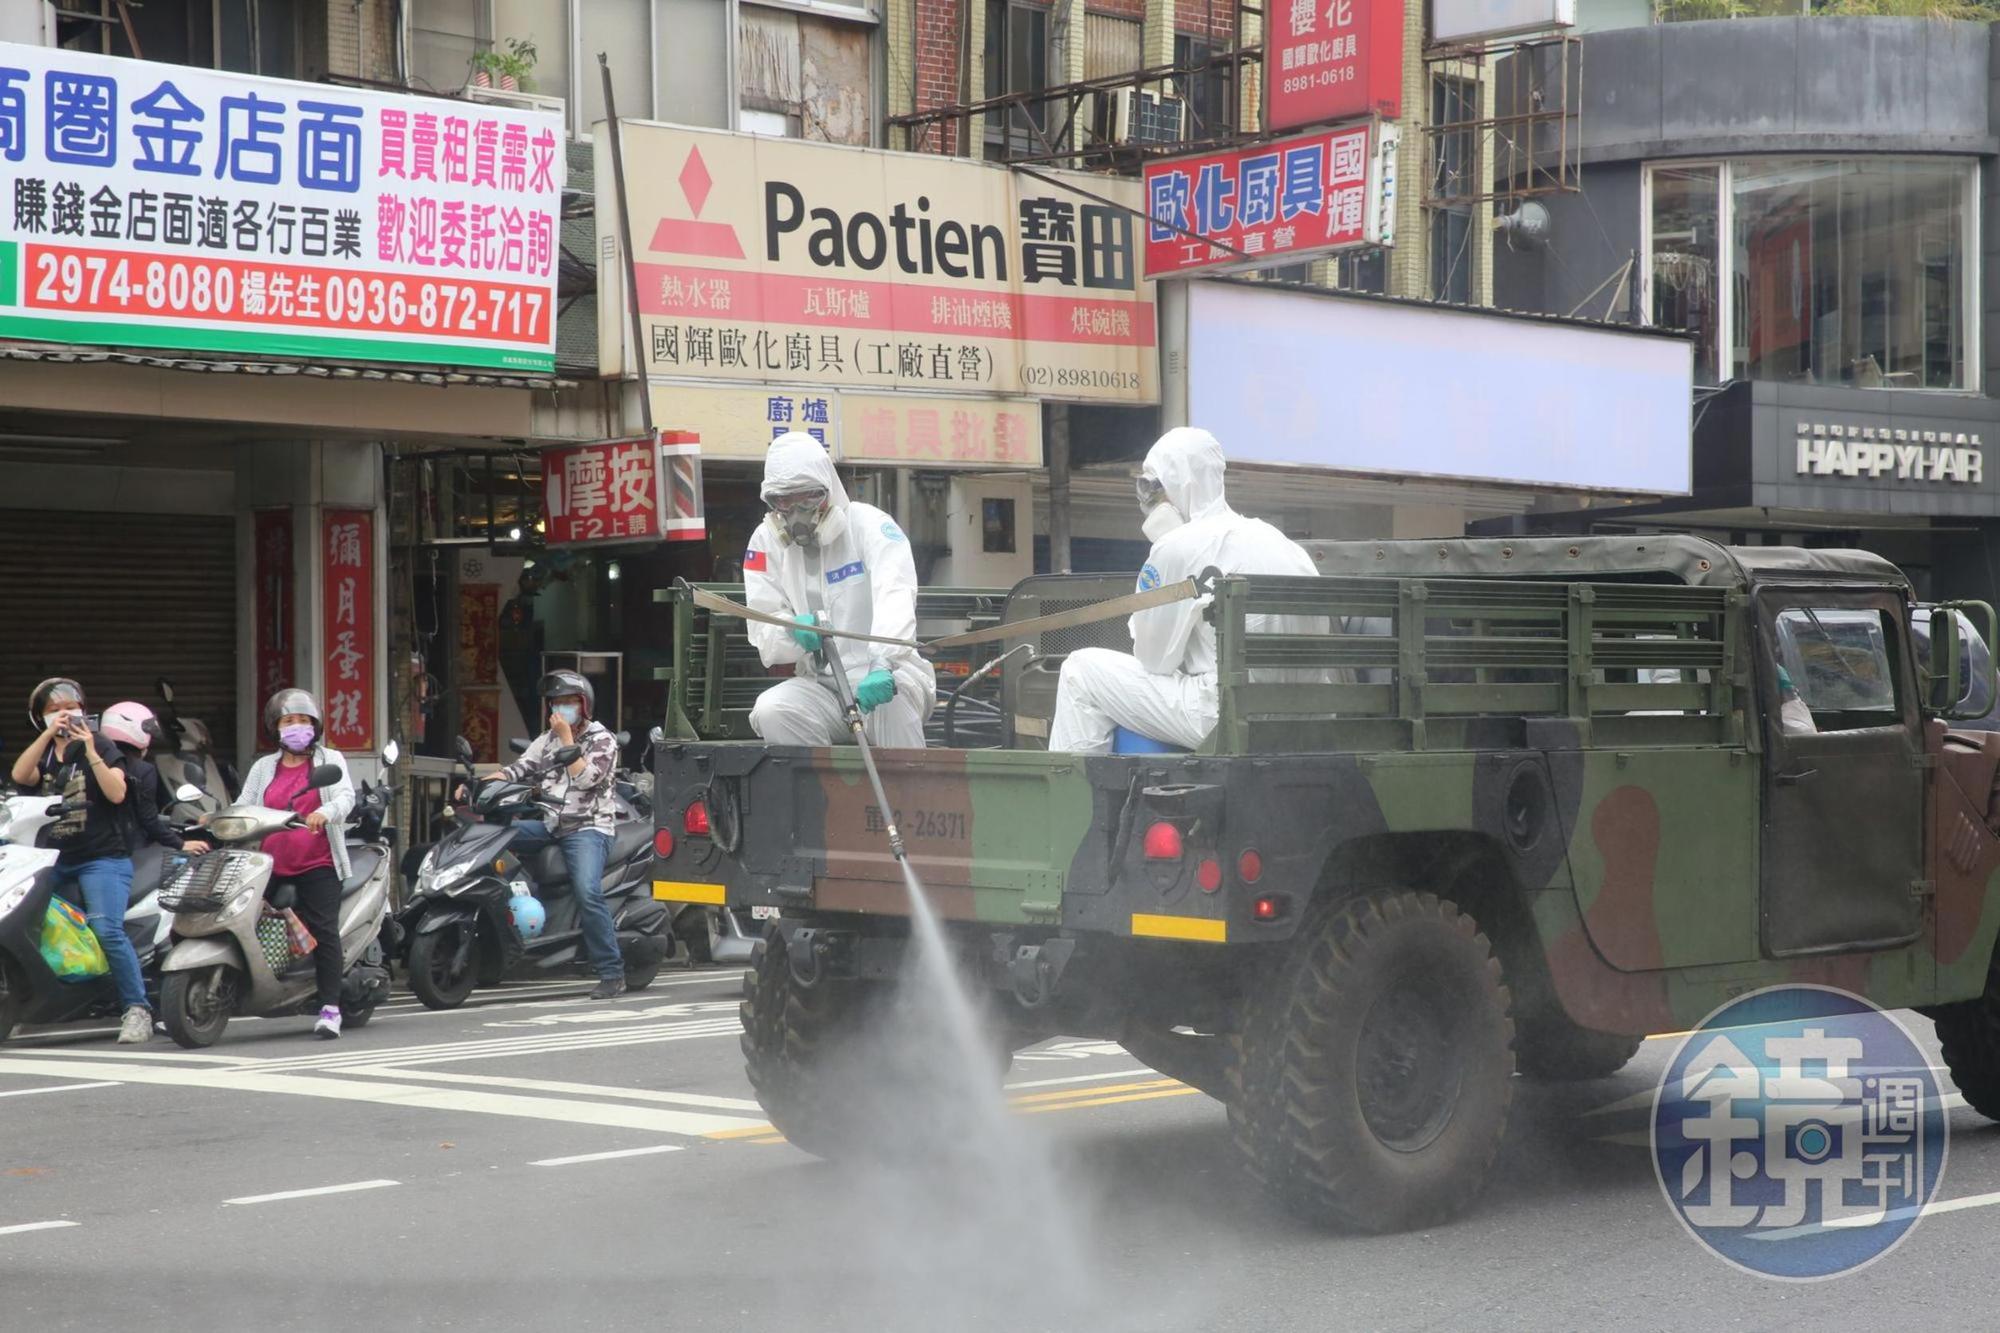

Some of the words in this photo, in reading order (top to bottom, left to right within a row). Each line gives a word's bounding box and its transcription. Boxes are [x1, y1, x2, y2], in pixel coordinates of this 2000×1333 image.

[1283, 65, 1354, 94] 8981-0618
[378, 108, 555, 193] 買賣租賃需求
[1326, 131, 1366, 238] 國輝
[14, 177, 361, 260] 賺錢金店面適各行百業
[377, 193, 552, 278] 歡迎委託洽詢
[765, 181, 1007, 281] Paotien
[1019, 197, 1135, 291] 寶田
[1179, 225, 1296, 265] 工廠直營
[661, 274, 731, 311] 熱水器
[803, 287, 871, 319] 瓦斯爐
[930, 296, 1013, 331] 排油煙機
[1071, 306, 1130, 337] 烘碗機
[1019, 364, 1142, 390] (02)89810618
[329, 523, 365, 736] 彌月蛋糕
